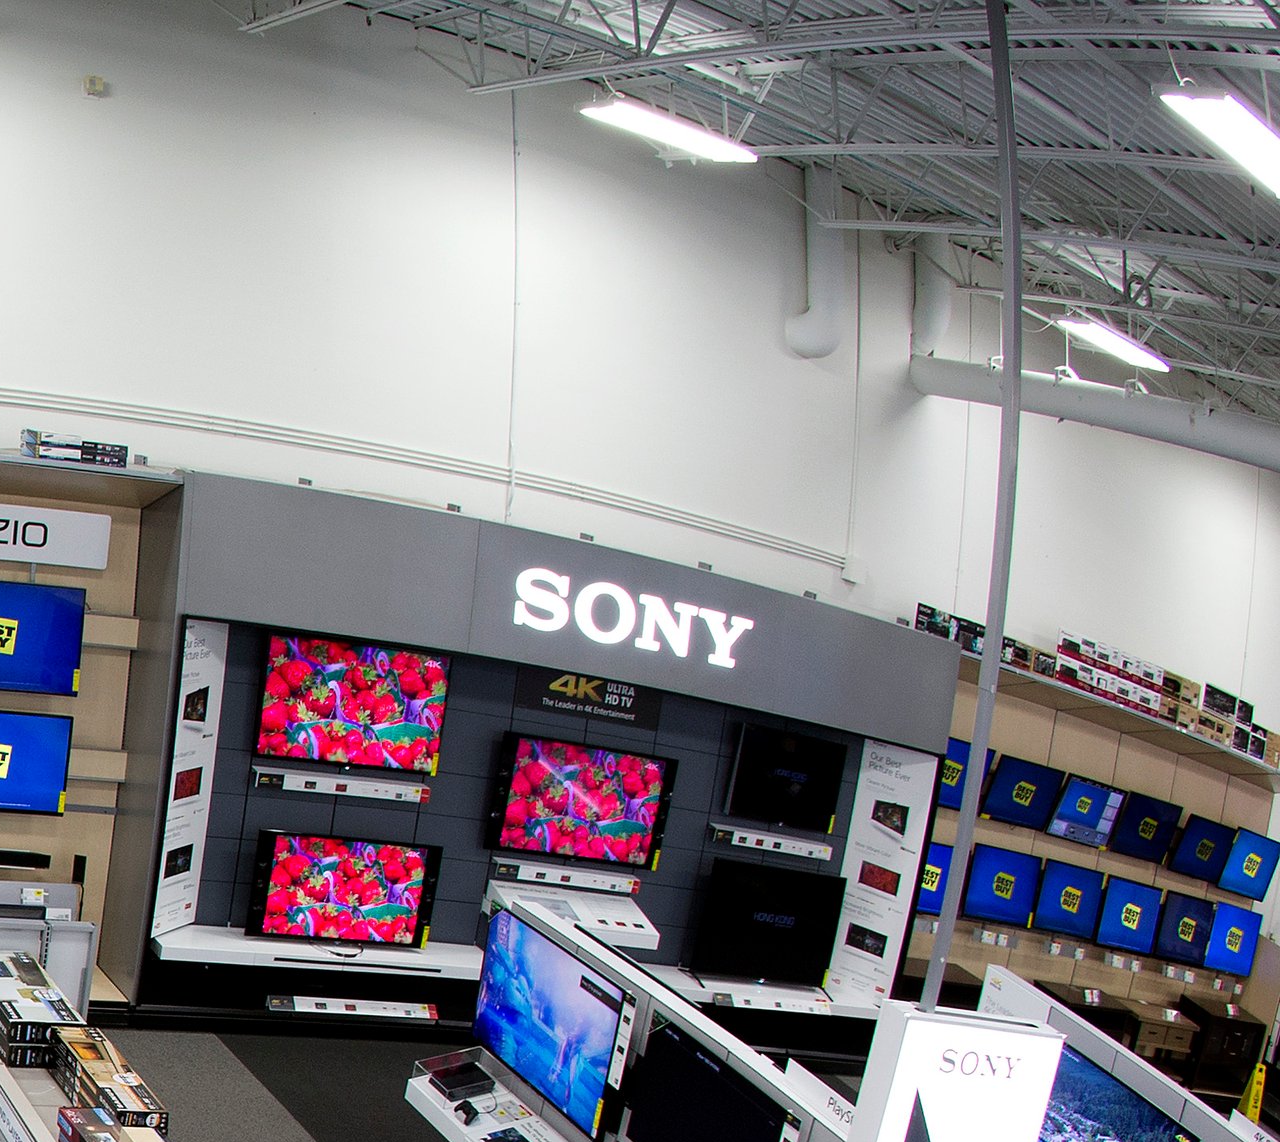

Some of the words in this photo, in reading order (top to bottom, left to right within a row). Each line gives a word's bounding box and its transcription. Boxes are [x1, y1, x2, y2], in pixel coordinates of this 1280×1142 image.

[513, 567, 754, 669] SONY
[425, 659, 442, 669] 4K
[549, 674, 605, 701] 4K
[607, 682, 635, 697] ULTRA
[605, 693, 620, 706] HD
[620, 695, 634, 708] TV
[542, 697, 555, 707] The
[555, 699, 576, 711] Leader
[584, 705, 592, 713] 4K
[593, 706, 635, 721] Entertainment
[644, 762, 659, 771] 4K
[870, 752, 883, 763] Our
[885, 756, 902, 769] Best
[868, 761, 893, 778] Picture
[895, 771, 910, 783] Ever
[1016, 783, 1035, 796] BEST
[1015, 791, 1032, 804] BUY
[1141, 819, 1157, 831] BEST
[1141, 826, 1155, 840] BUY
[1246, 854, 1261, 867] BEST
[1245, 863, 1258, 876] BUY
[995, 875, 1014, 889] BEST
[994, 884, 1011, 898] BUY
[1063, 889, 1082, 903] BEST
[1062, 898, 1078, 911] BUY
[754, 911, 774, 921] HONG
[775, 913, 795, 923] KONG
[1124, 906, 1140, 919] BEST
[1123, 914, 1138, 928] BUY
[1181, 919, 1196, 932] BEST
[1180, 927, 1193, 941] BUY
[1228, 929, 1243, 942] BEST
[1227, 937, 1239, 951] BUY
[939, 1048, 1024, 1079] SONY
